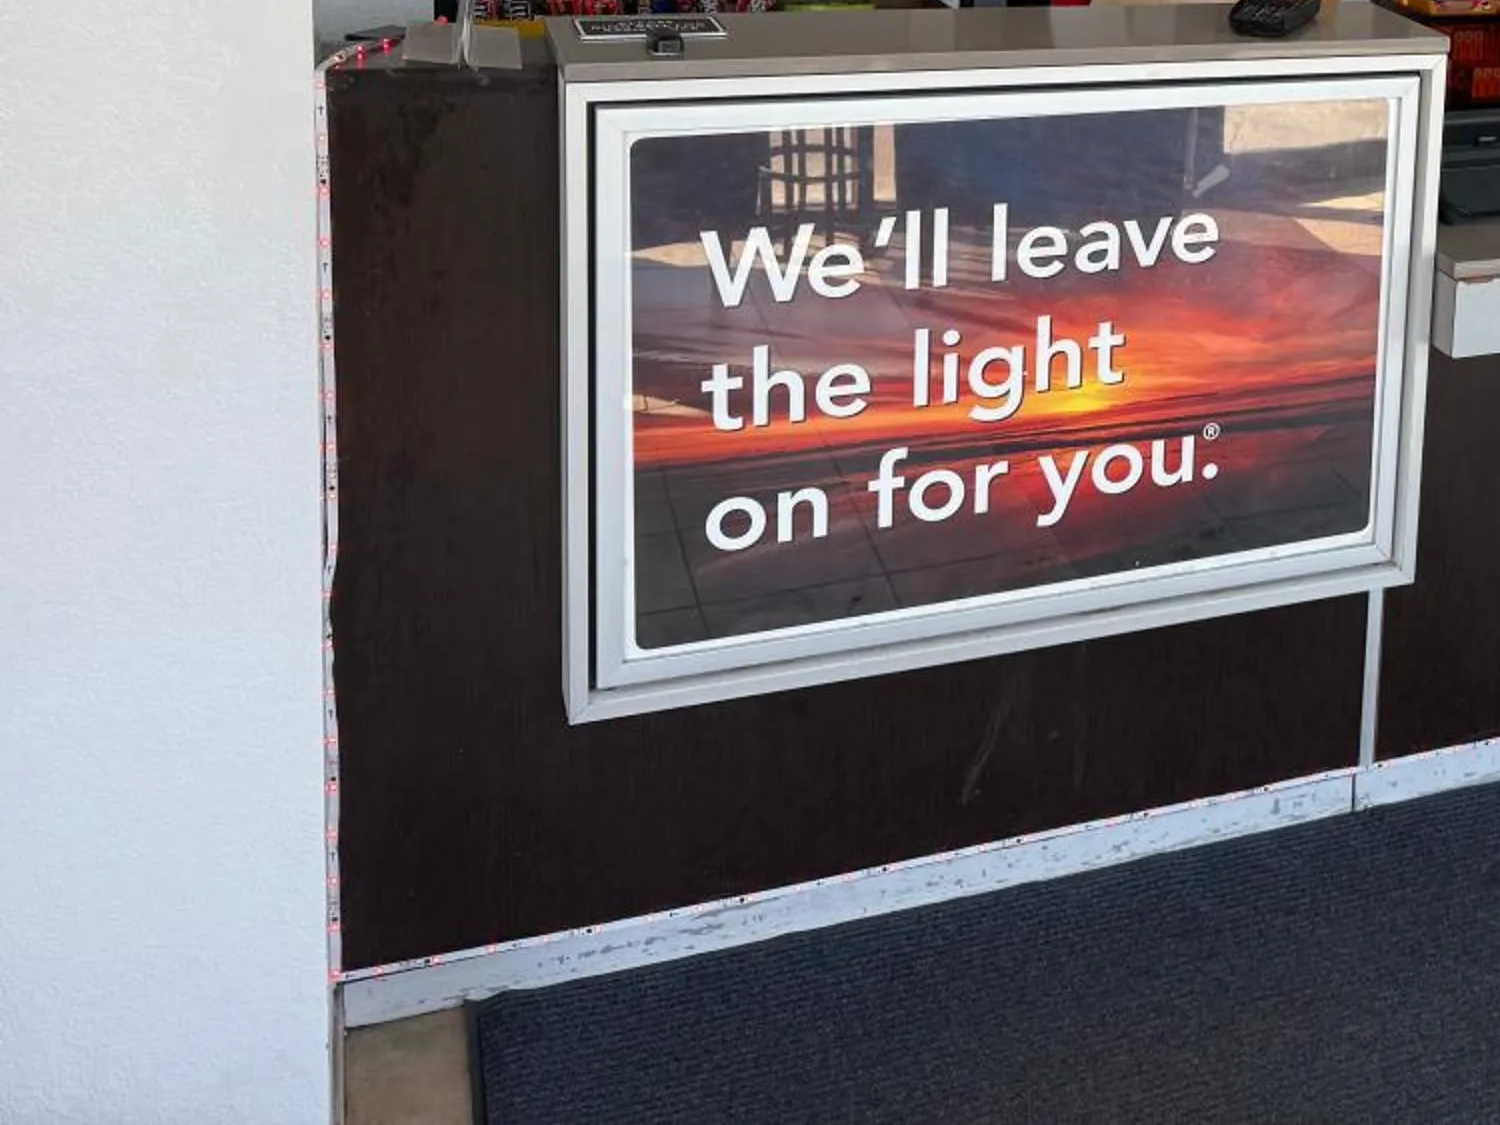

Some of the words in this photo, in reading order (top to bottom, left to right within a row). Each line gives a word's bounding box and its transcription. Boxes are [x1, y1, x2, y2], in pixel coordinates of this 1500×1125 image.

[700, 206, 948, 308] We'll
[991, 202, 1220, 283] leave
[701, 344, 872, 431] the
[912, 313, 1126, 423] light
[704, 484, 829, 553] on
[867, 446, 1009, 529] for
